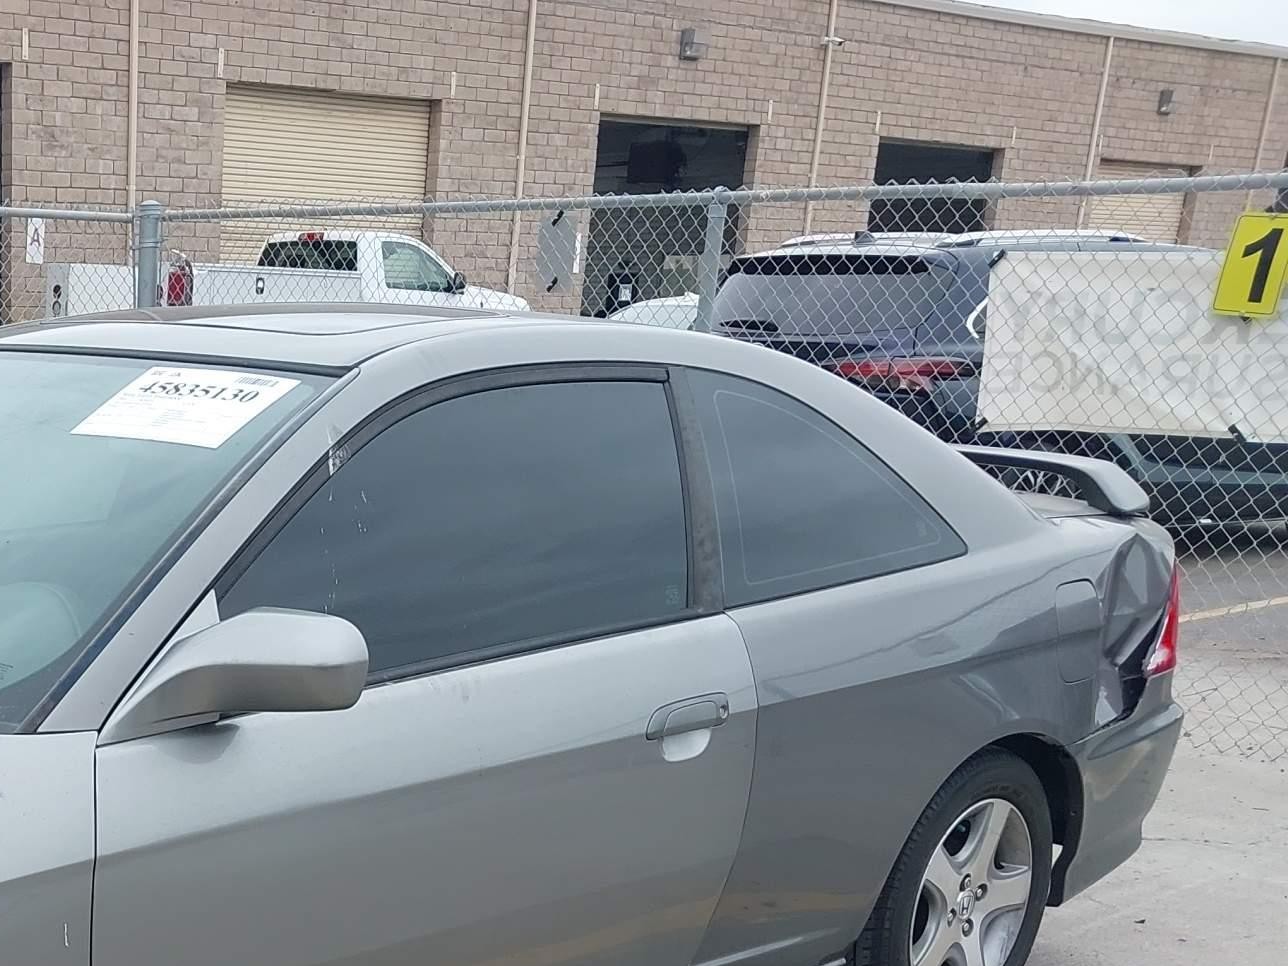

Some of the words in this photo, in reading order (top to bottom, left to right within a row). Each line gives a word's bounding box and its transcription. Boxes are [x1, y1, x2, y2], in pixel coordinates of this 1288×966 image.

[30, 228, 41, 247] A
[1241, 228, 1284, 304] 1
[139, 381, 260, 403] 45835130
